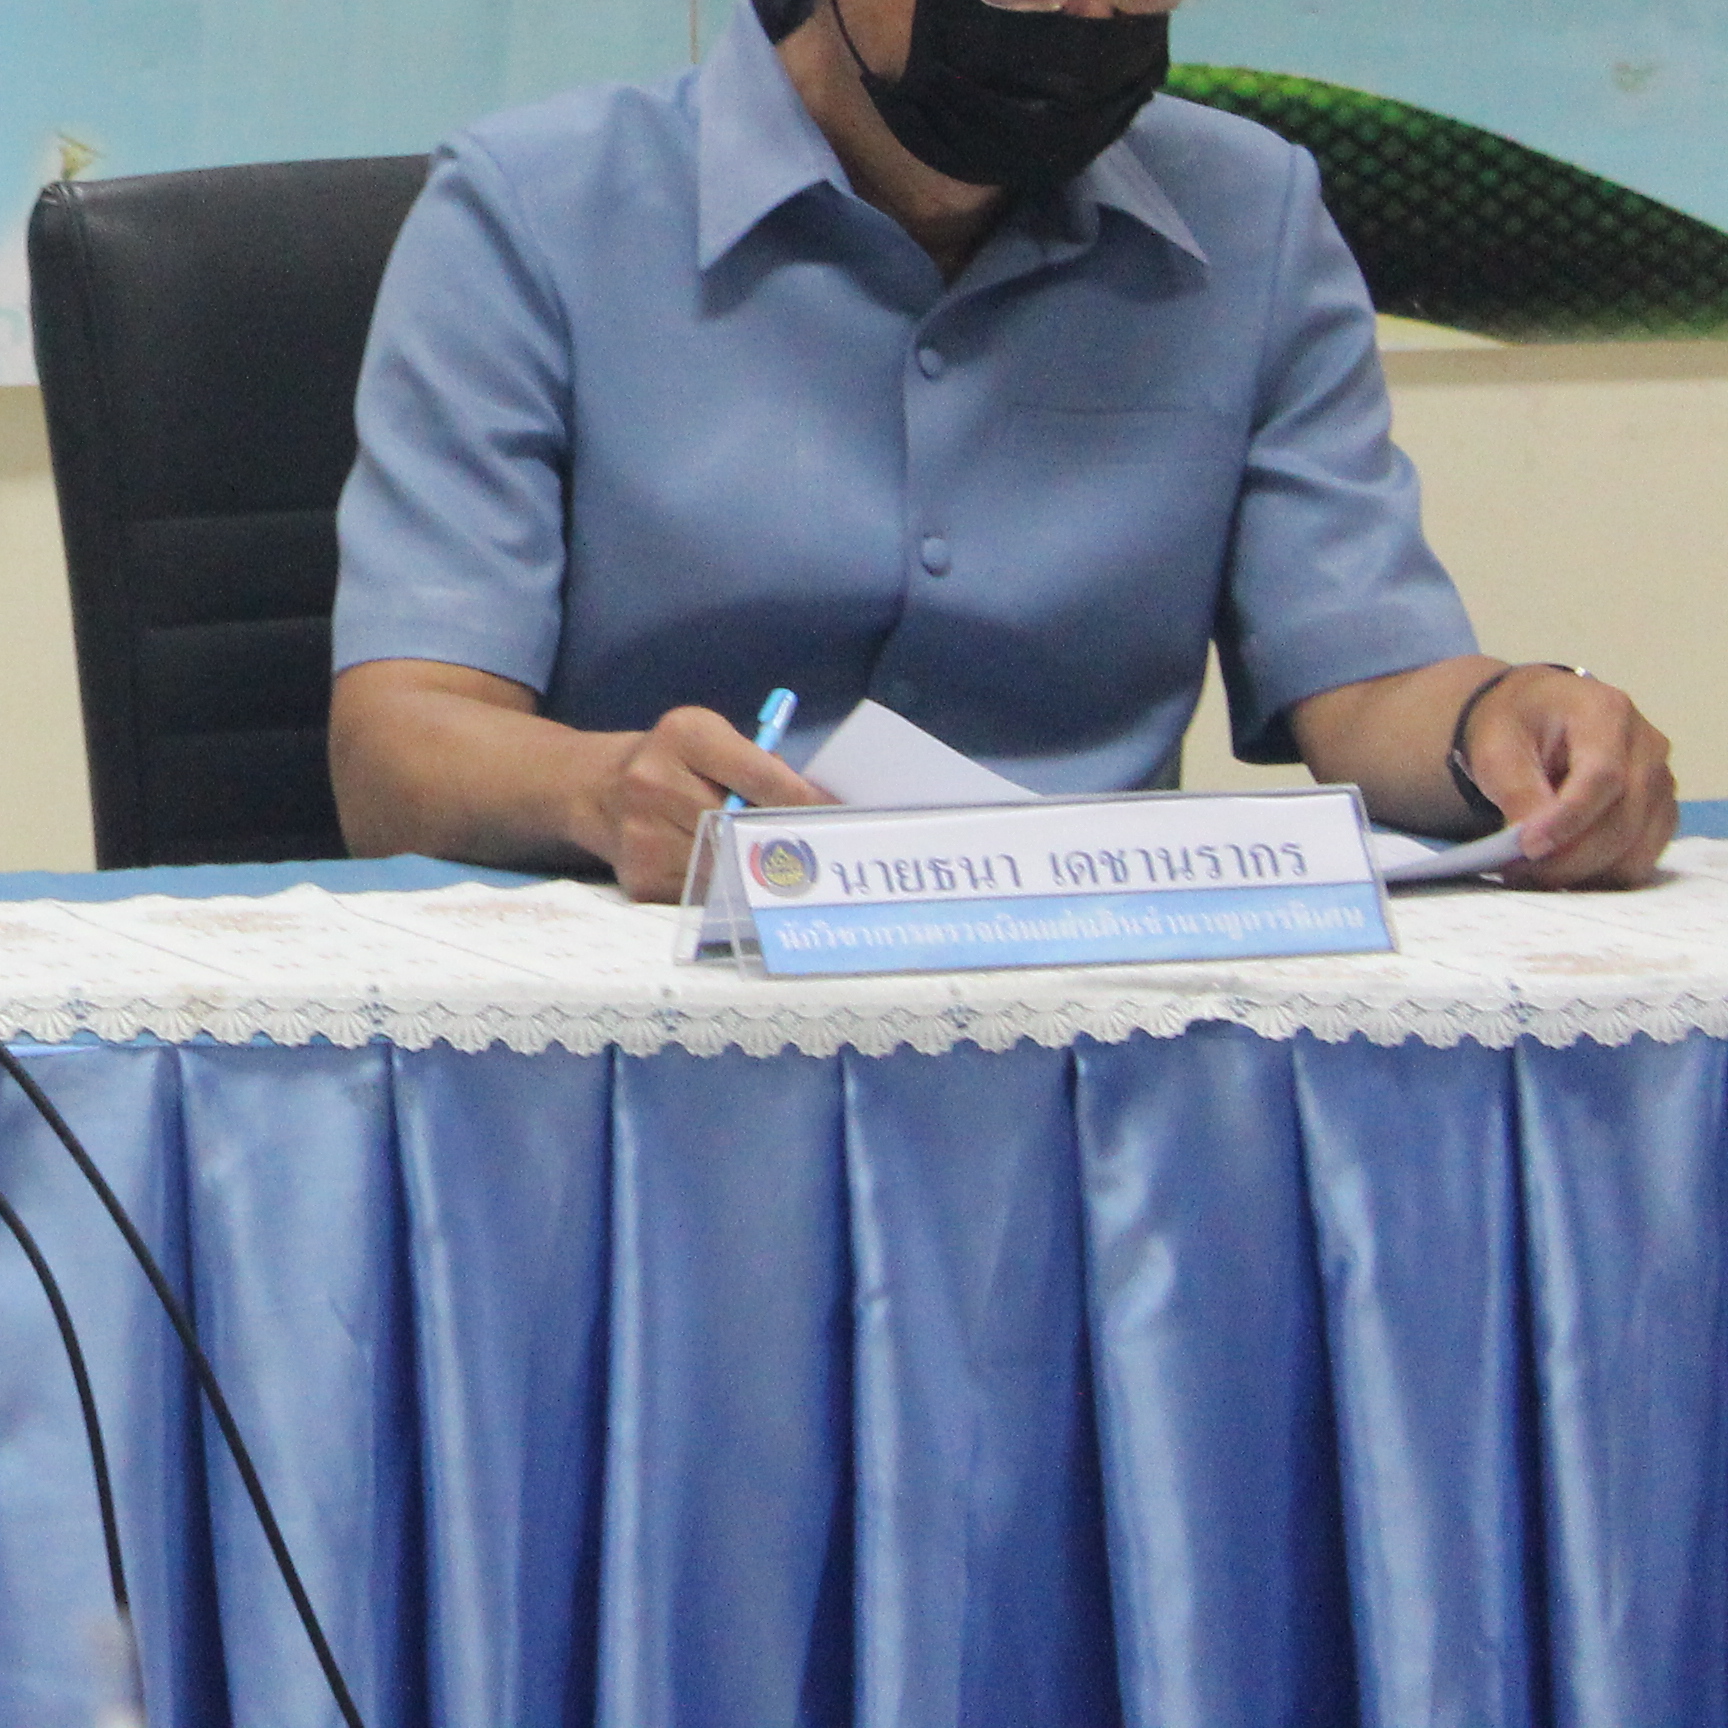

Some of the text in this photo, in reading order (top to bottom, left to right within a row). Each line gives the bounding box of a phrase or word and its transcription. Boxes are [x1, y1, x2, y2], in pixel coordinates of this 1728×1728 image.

[831, 851, 1023, 896] นายธนา
[1050, 840, 1310, 886] เดชานรากร
